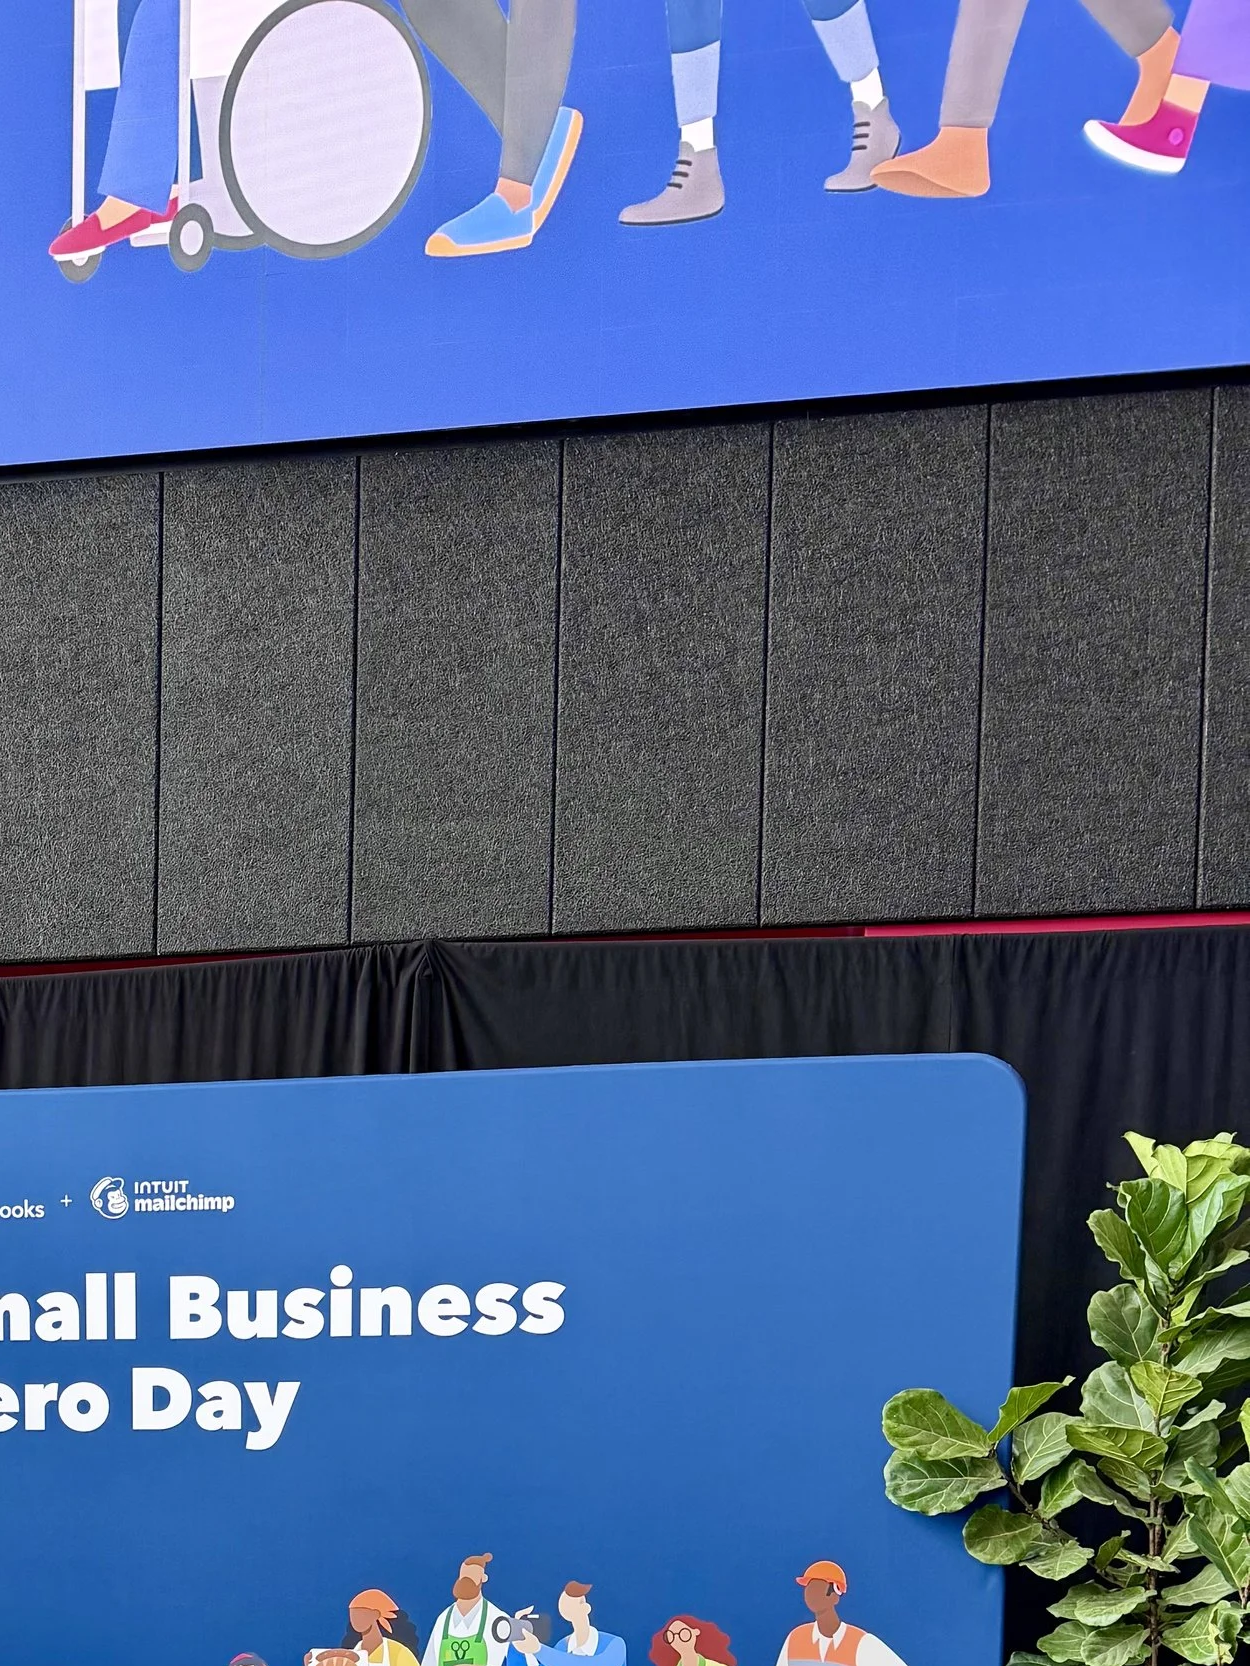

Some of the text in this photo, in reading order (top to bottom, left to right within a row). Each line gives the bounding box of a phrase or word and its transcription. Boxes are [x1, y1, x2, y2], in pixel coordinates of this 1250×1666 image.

[134, 1194, 235, 1213] mailchimp
[135, 1180, 189, 1194] INTUIT
[169, 1265, 567, 1340] Business
[133, 1367, 301, 1451] Day
